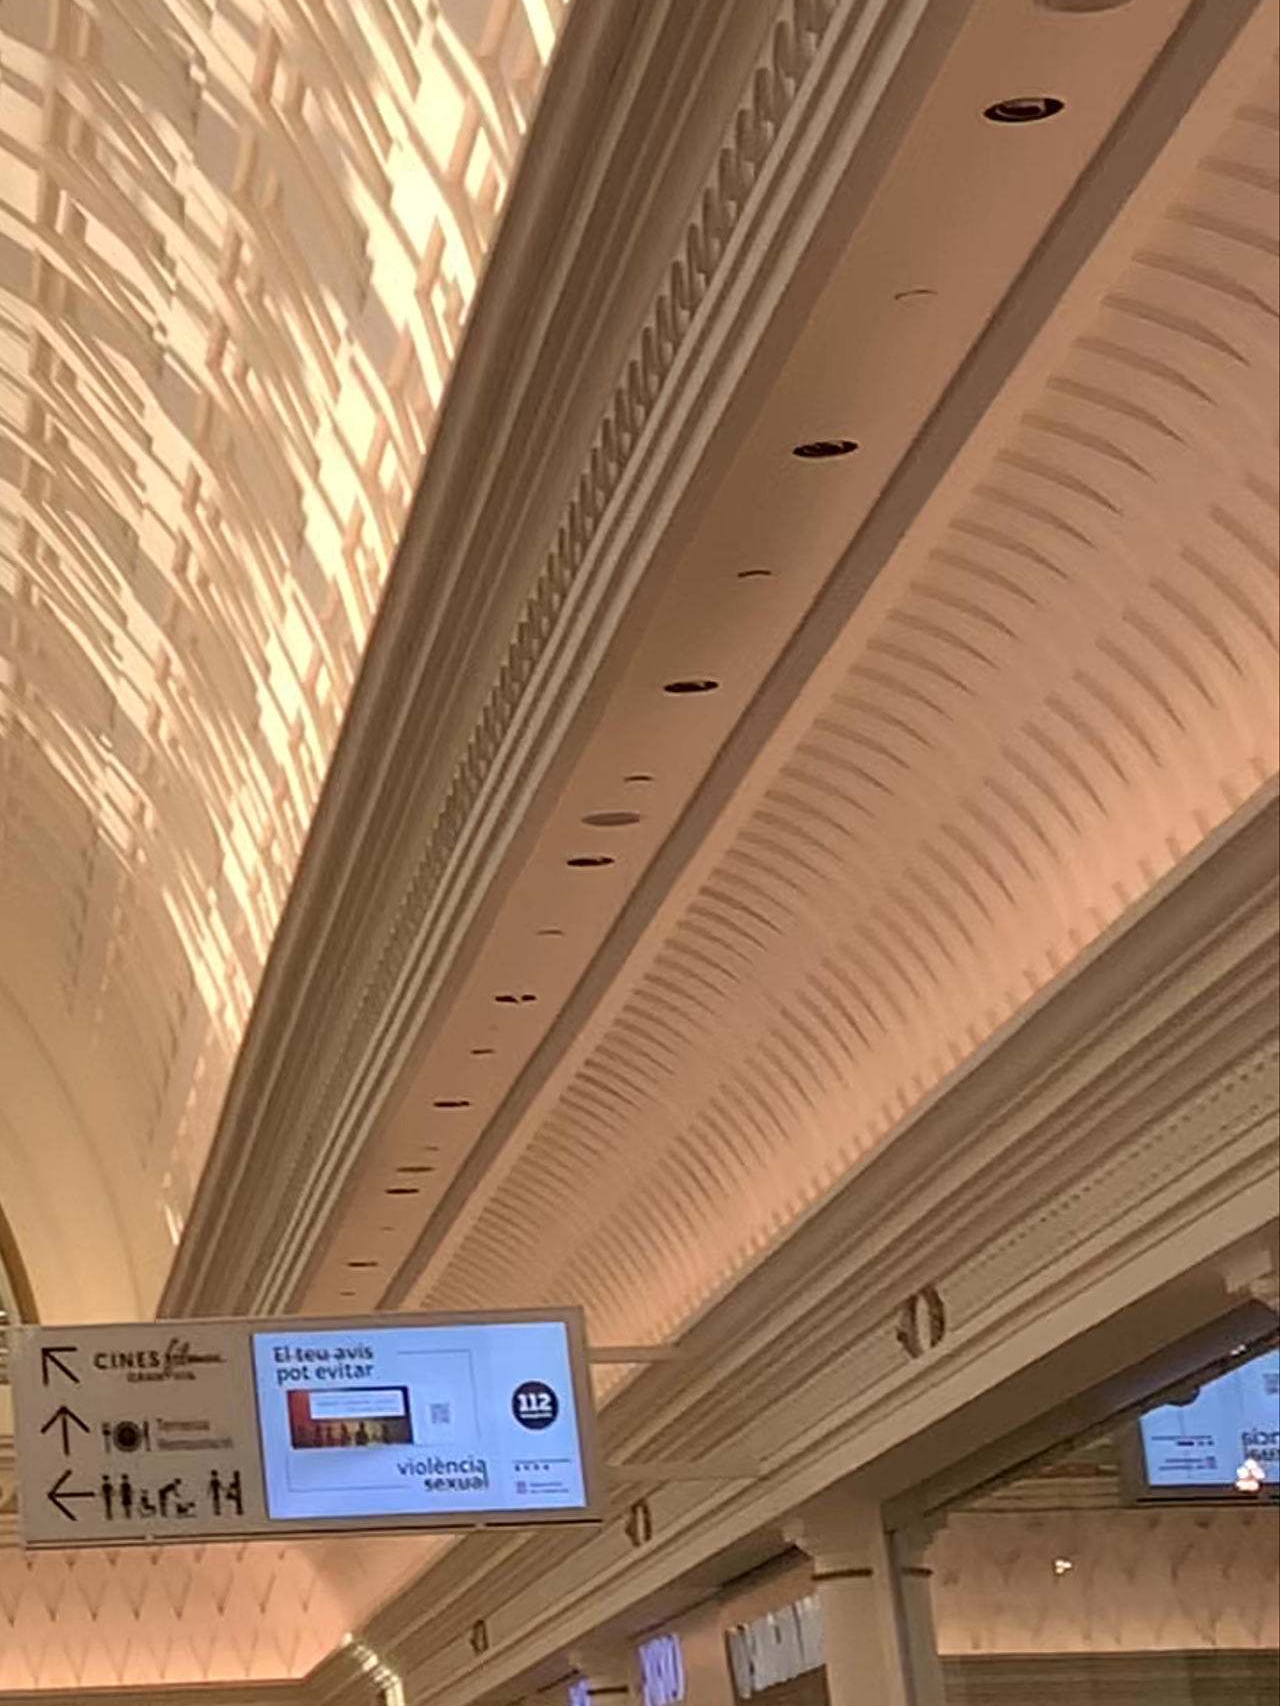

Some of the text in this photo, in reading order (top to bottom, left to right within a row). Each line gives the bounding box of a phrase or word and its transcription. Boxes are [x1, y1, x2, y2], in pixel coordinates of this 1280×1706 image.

[93, 1351, 160, 1369] CINES
[273, 1346, 374, 1363] El teu avis
[277, 1363, 375, 1386] pot evitar
[518, 1394, 552, 1411] 112
[397, 1457, 487, 1475] violència
[424, 1476, 489, 1492] sexual
